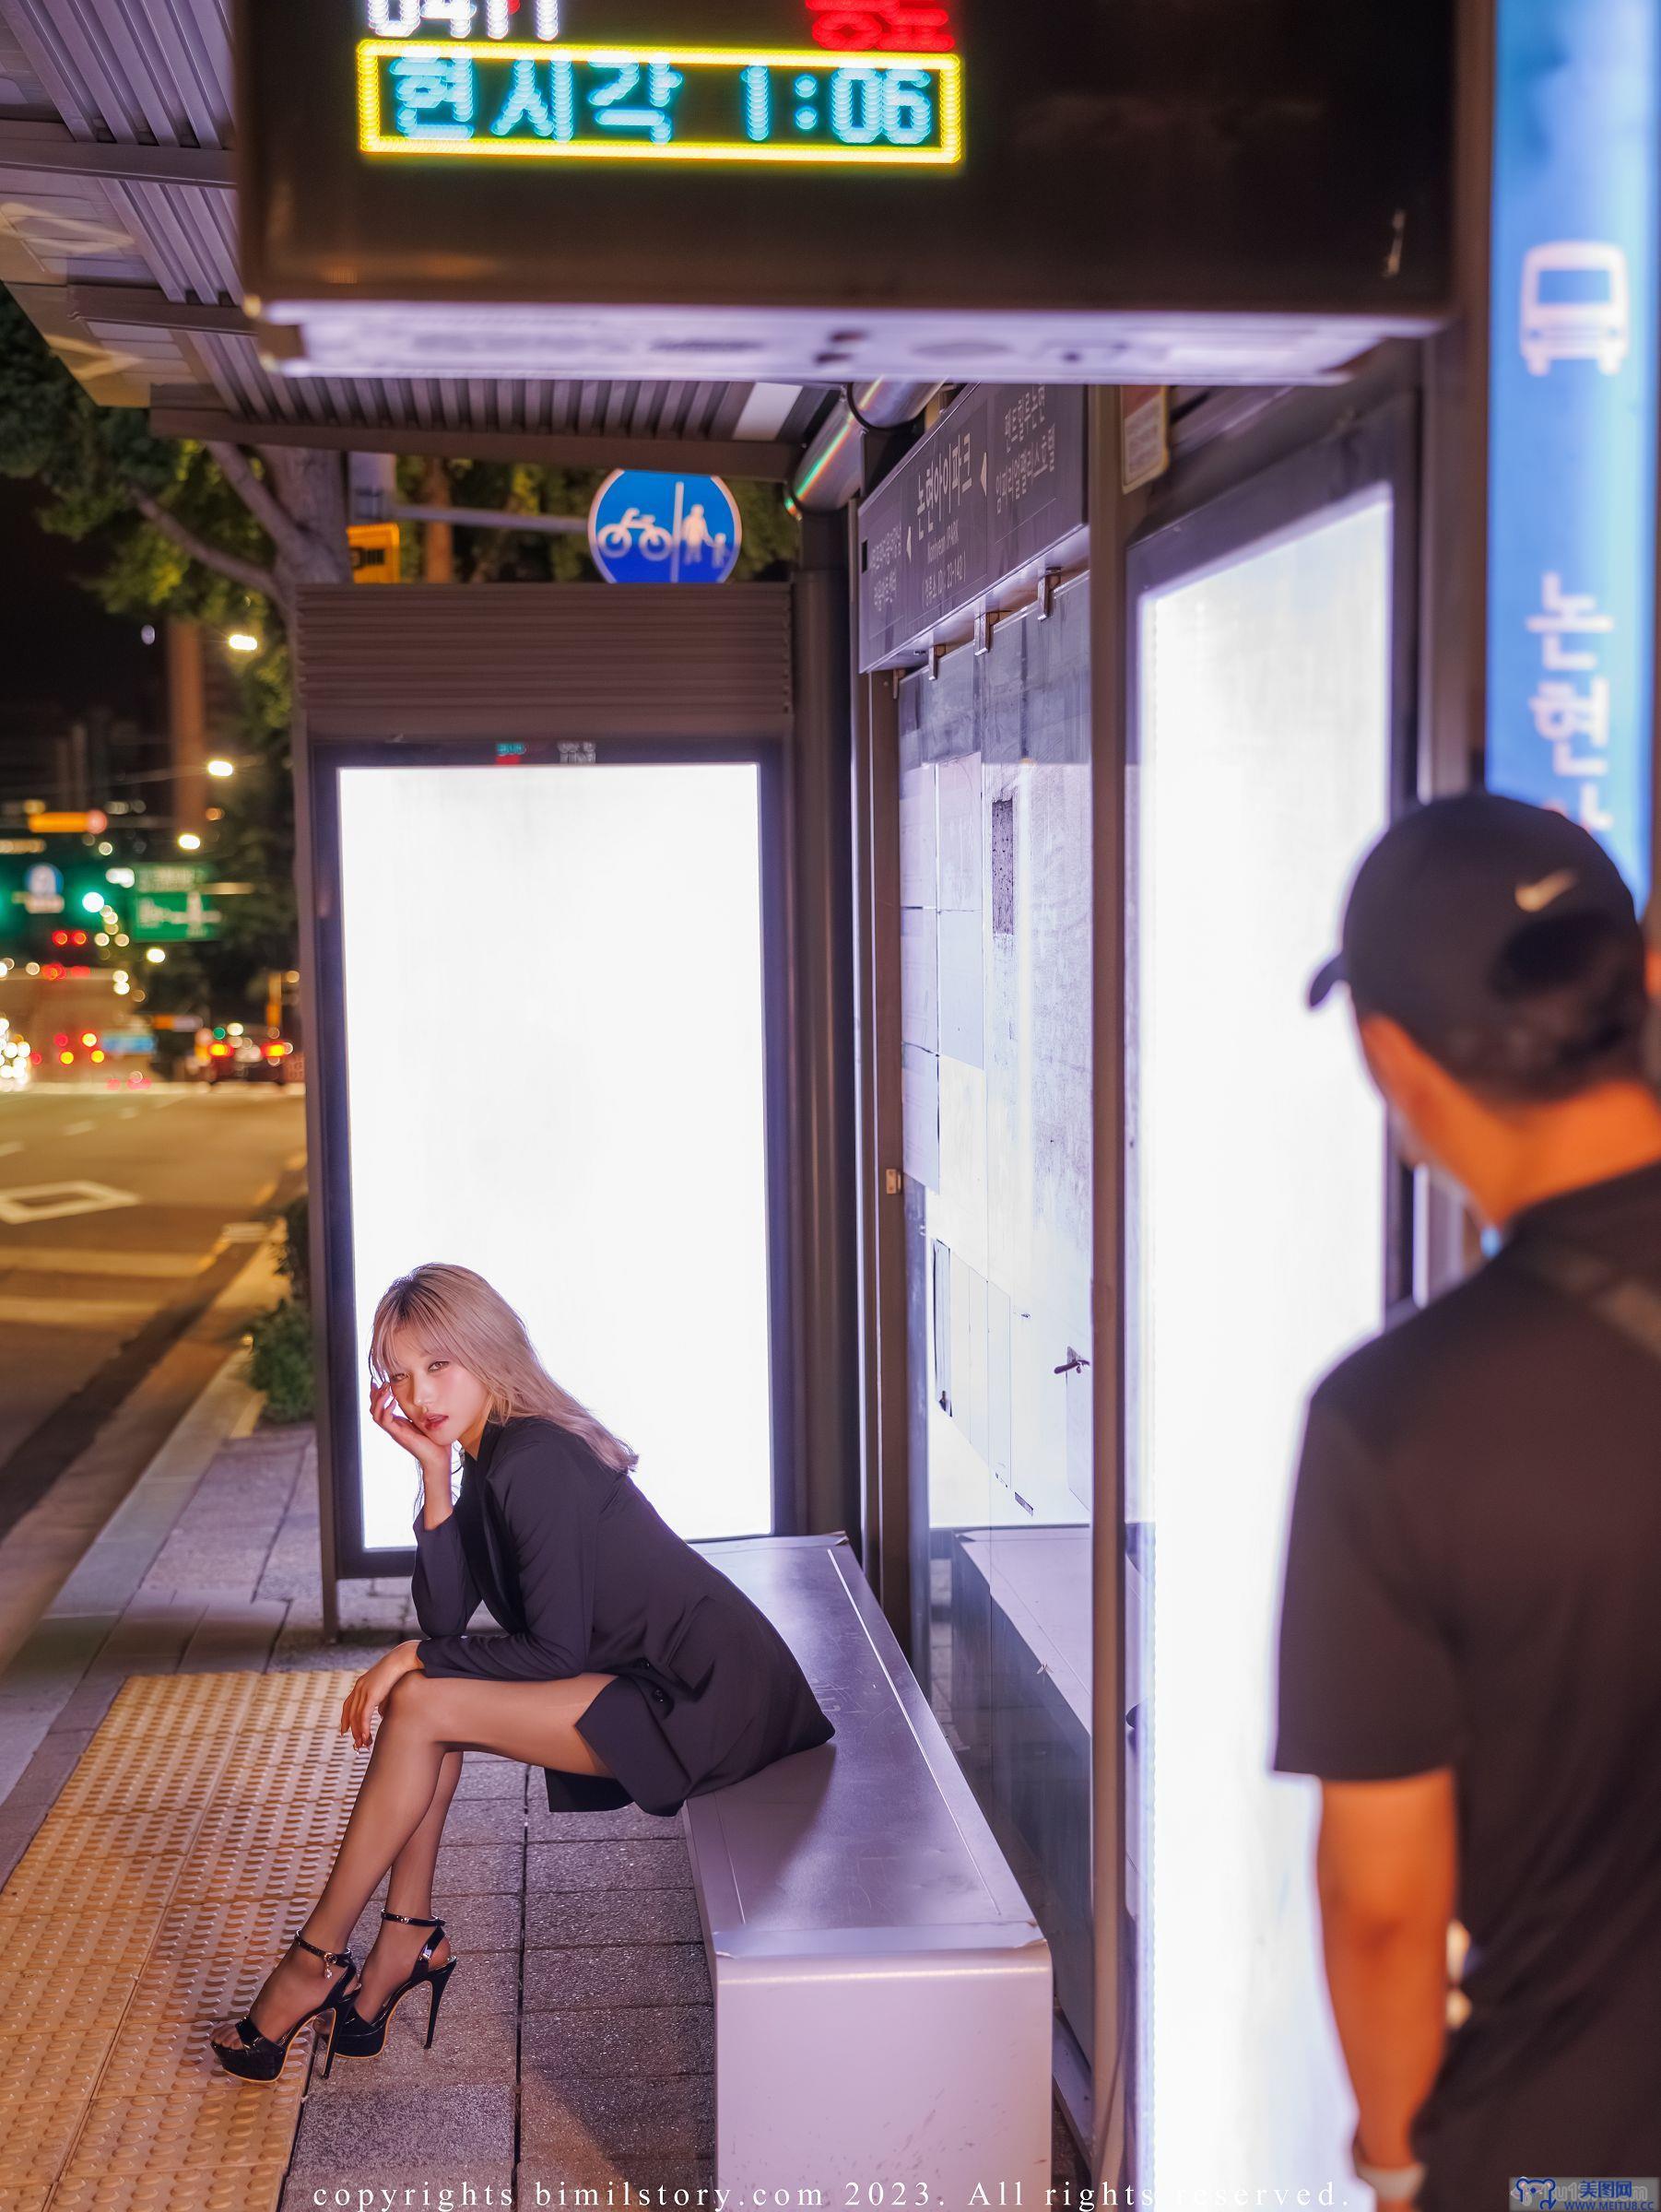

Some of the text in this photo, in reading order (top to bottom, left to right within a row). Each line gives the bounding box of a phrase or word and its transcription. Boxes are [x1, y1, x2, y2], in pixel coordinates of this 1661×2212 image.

[390, 46, 932, 145] 현시각 1:06
[916, 432, 973, 542] 논현아이파크
